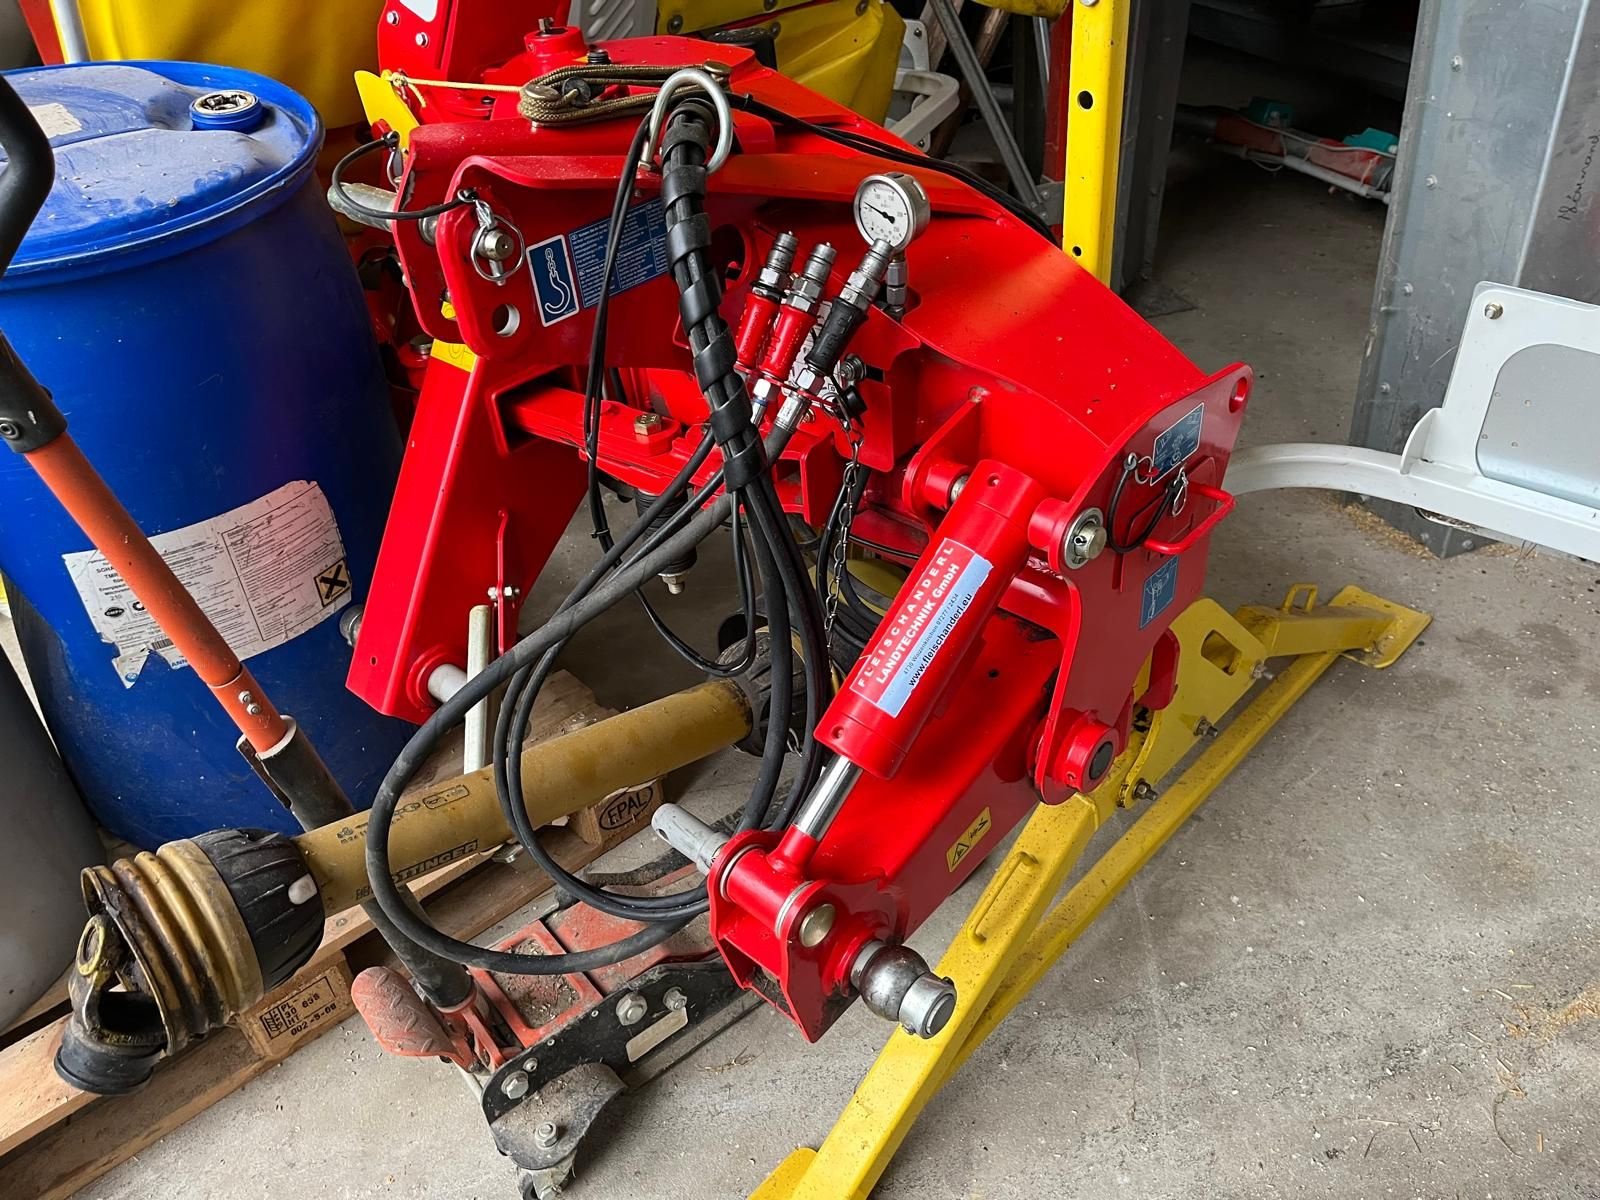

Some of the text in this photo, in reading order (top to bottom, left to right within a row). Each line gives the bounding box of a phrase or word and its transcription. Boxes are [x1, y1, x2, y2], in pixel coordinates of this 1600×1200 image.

[857, 547, 954, 688] FLEISCHANDERL
[875, 563, 960, 683] LANDTECHNIK GmbH
[908, 592, 973, 687] www.fleischanderl.eu
[606, 792, 648, 826] EPAL
[391, 840, 478, 882] TTINGER
[284, 1007, 297, 1018] 30
